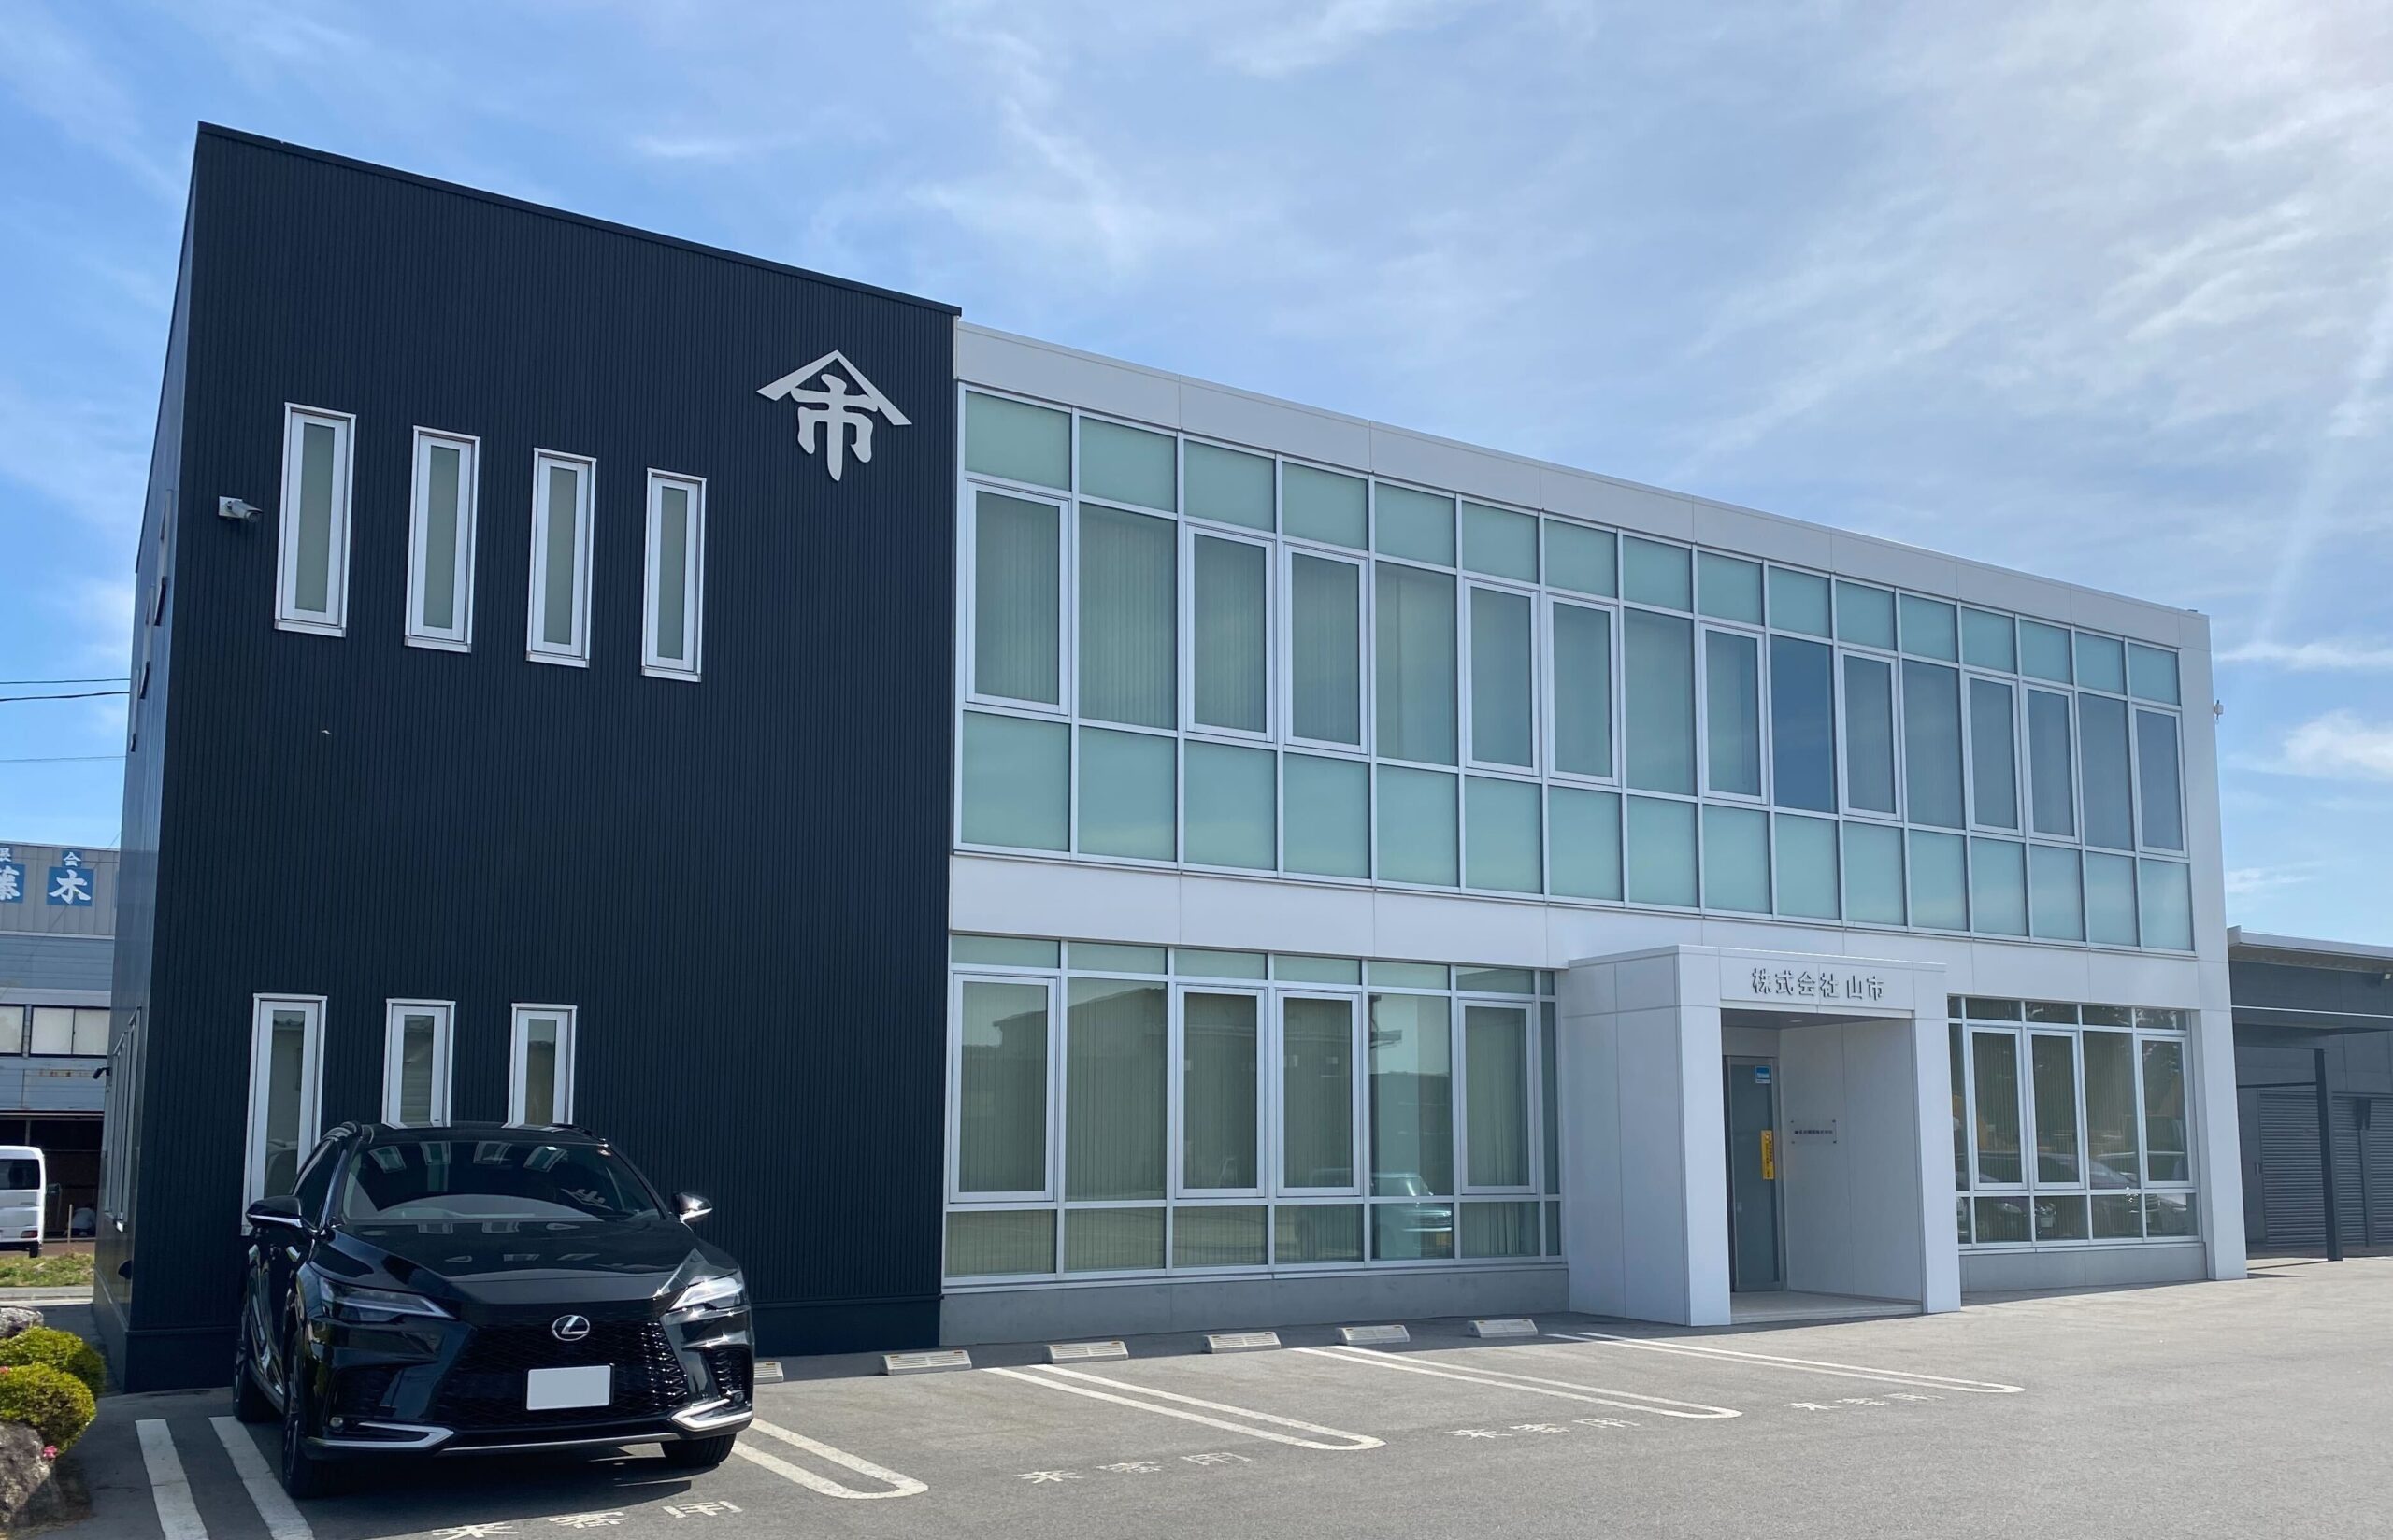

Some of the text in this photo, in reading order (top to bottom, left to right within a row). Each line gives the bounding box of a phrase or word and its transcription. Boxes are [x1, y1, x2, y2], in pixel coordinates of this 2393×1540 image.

[1752, 967, 1884, 1001] 株式会社山市
[1012, 1451, 1253, 1484] 来客用
